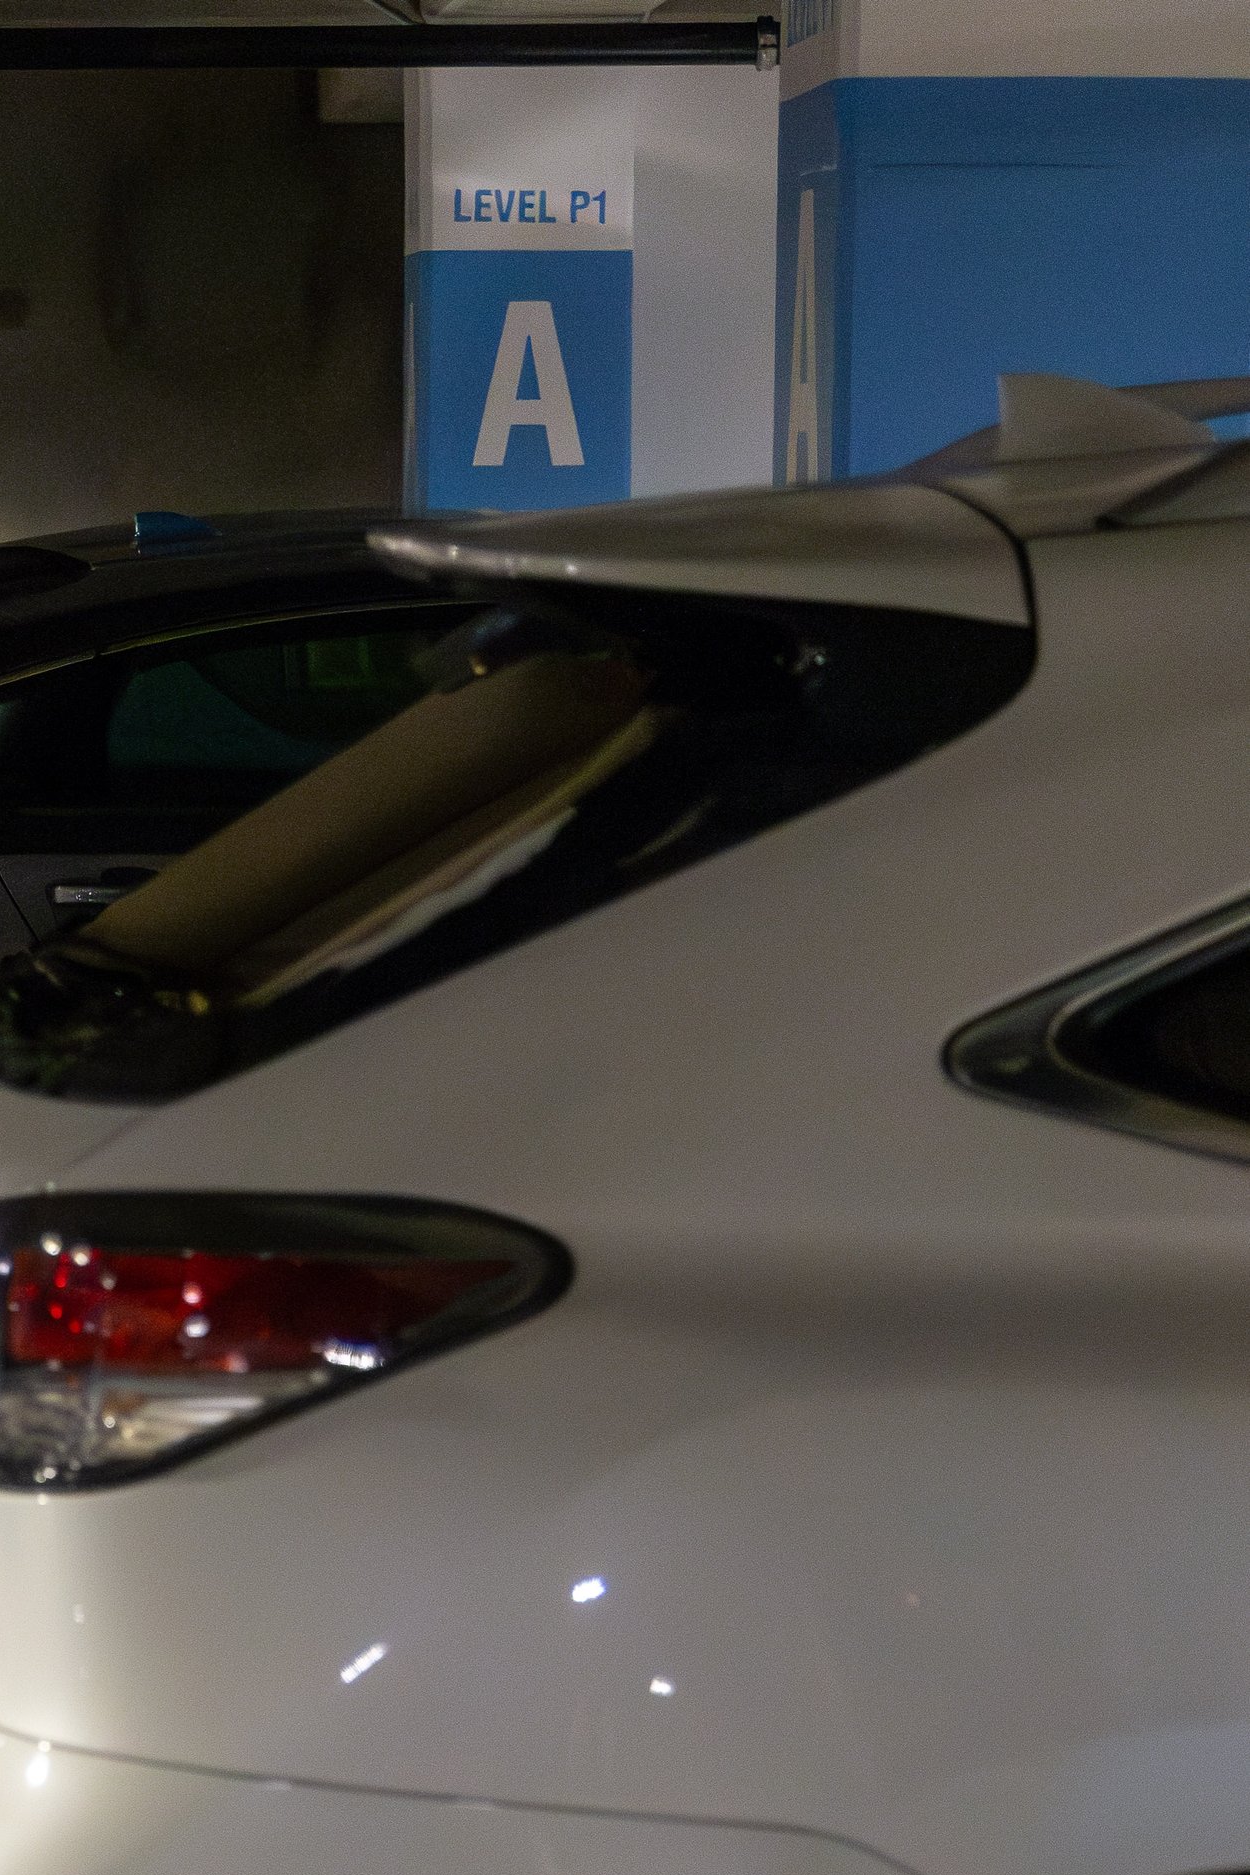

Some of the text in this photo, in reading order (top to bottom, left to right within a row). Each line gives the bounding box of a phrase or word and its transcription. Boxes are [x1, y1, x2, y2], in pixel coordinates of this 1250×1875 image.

[454, 189, 607, 224] LEVEL P1
[472, 301, 585, 466] A
[786, 188, 818, 485] A
